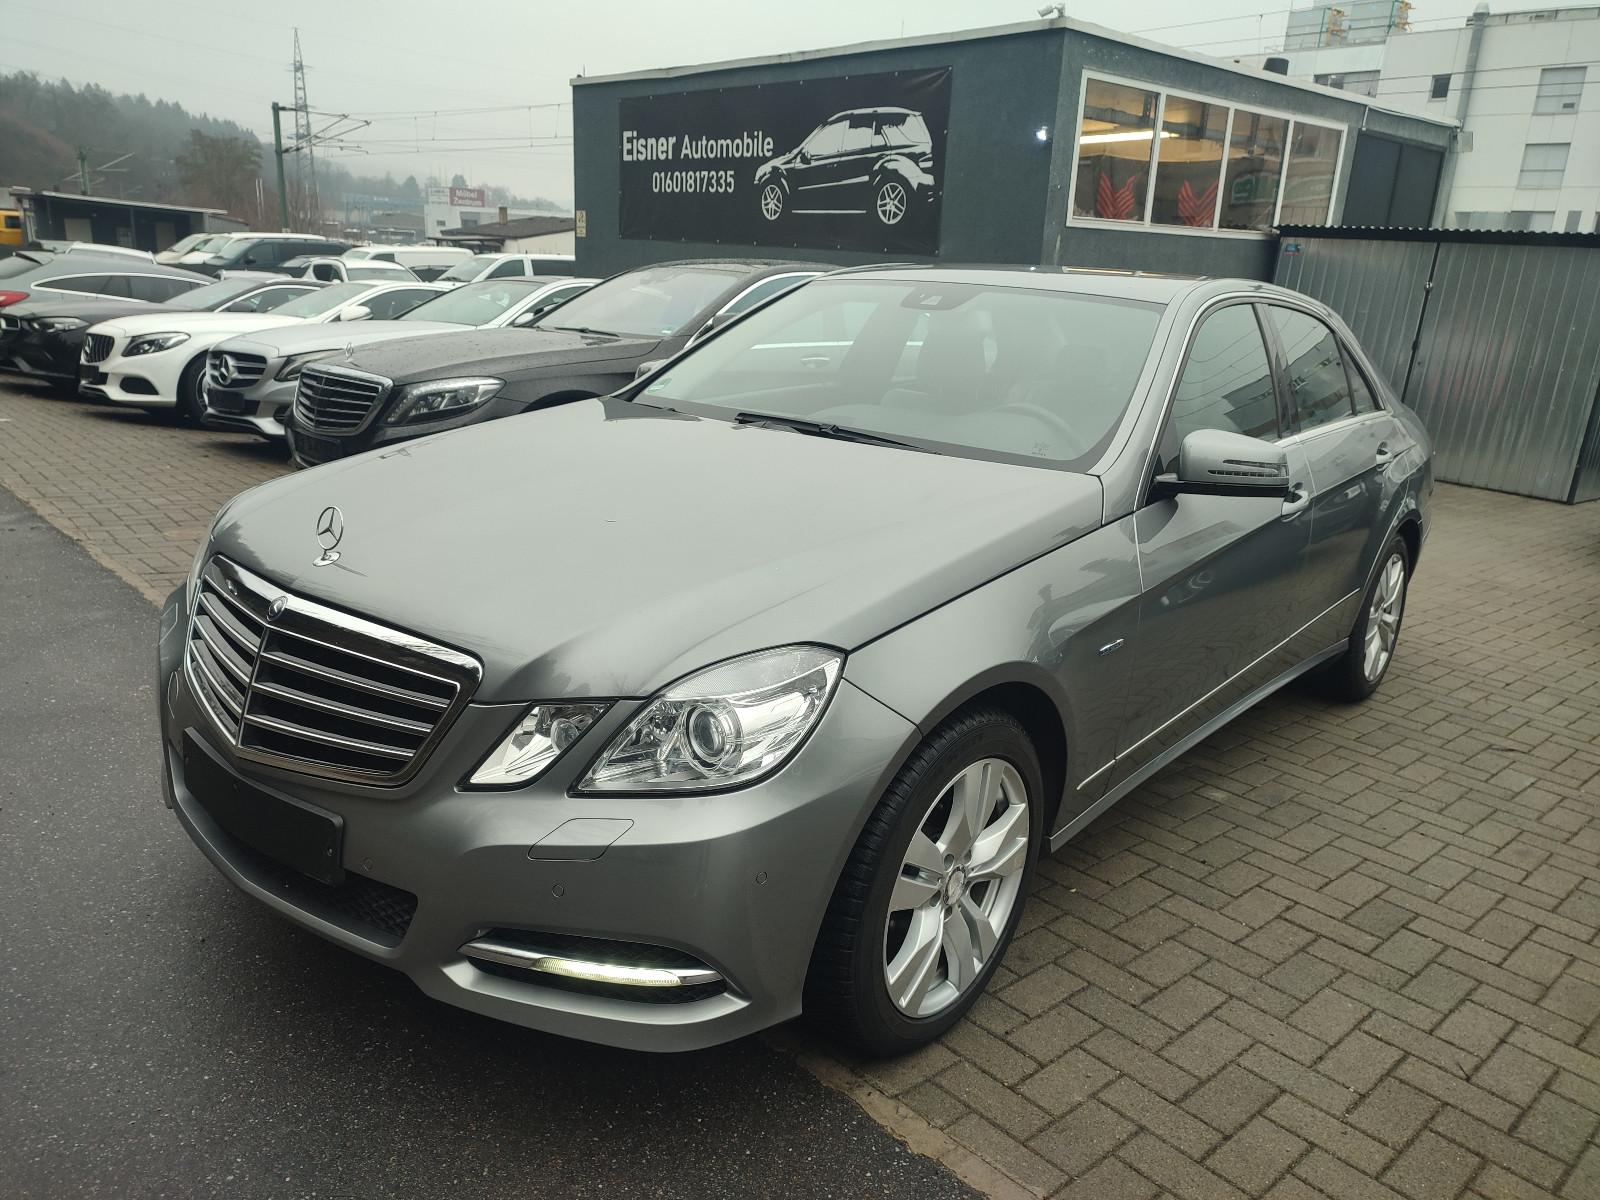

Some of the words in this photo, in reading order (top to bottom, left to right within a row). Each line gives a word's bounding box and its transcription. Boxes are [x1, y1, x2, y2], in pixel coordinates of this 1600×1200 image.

[623, 130, 676, 162] Eisner
[680, 130, 774, 160] Automobile
[652, 170, 735, 193] 01601817335
